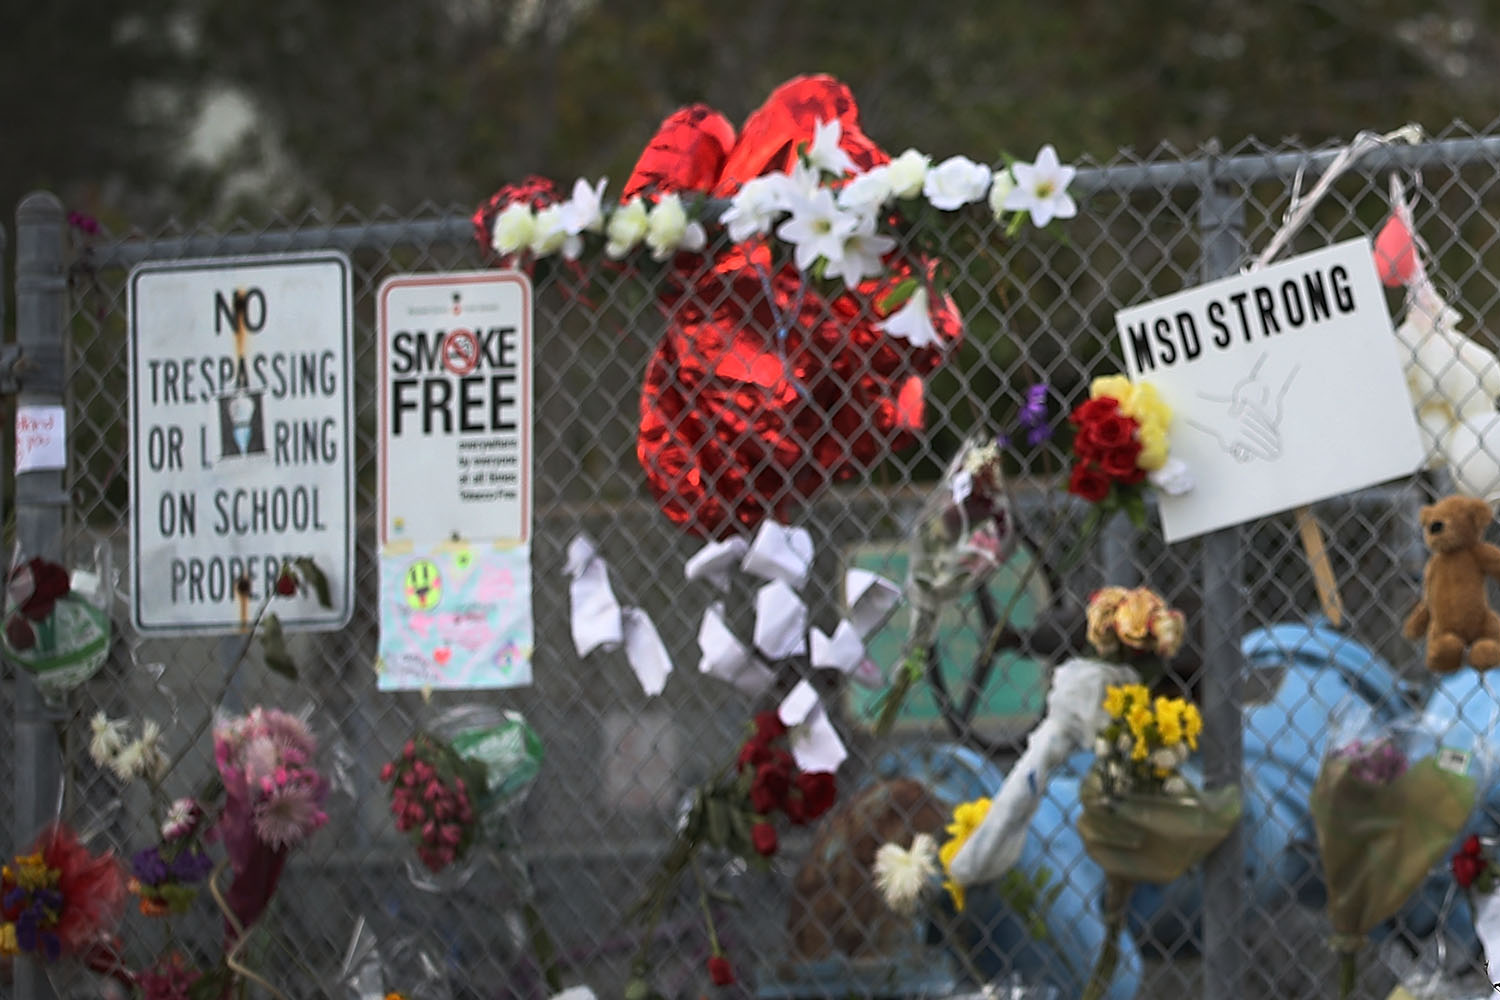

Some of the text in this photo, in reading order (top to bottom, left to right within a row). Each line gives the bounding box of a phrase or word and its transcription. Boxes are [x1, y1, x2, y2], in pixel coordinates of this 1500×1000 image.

[214, 286, 267, 335] NO
[1128, 265, 1356, 374] MSD STRONG
[149, 351, 337, 405] TRESPASSING
[392, 375, 518, 435] FREE
[149, 417, 338, 472] OR LRING
[159, 485, 326, 538] ON SCHOOL
